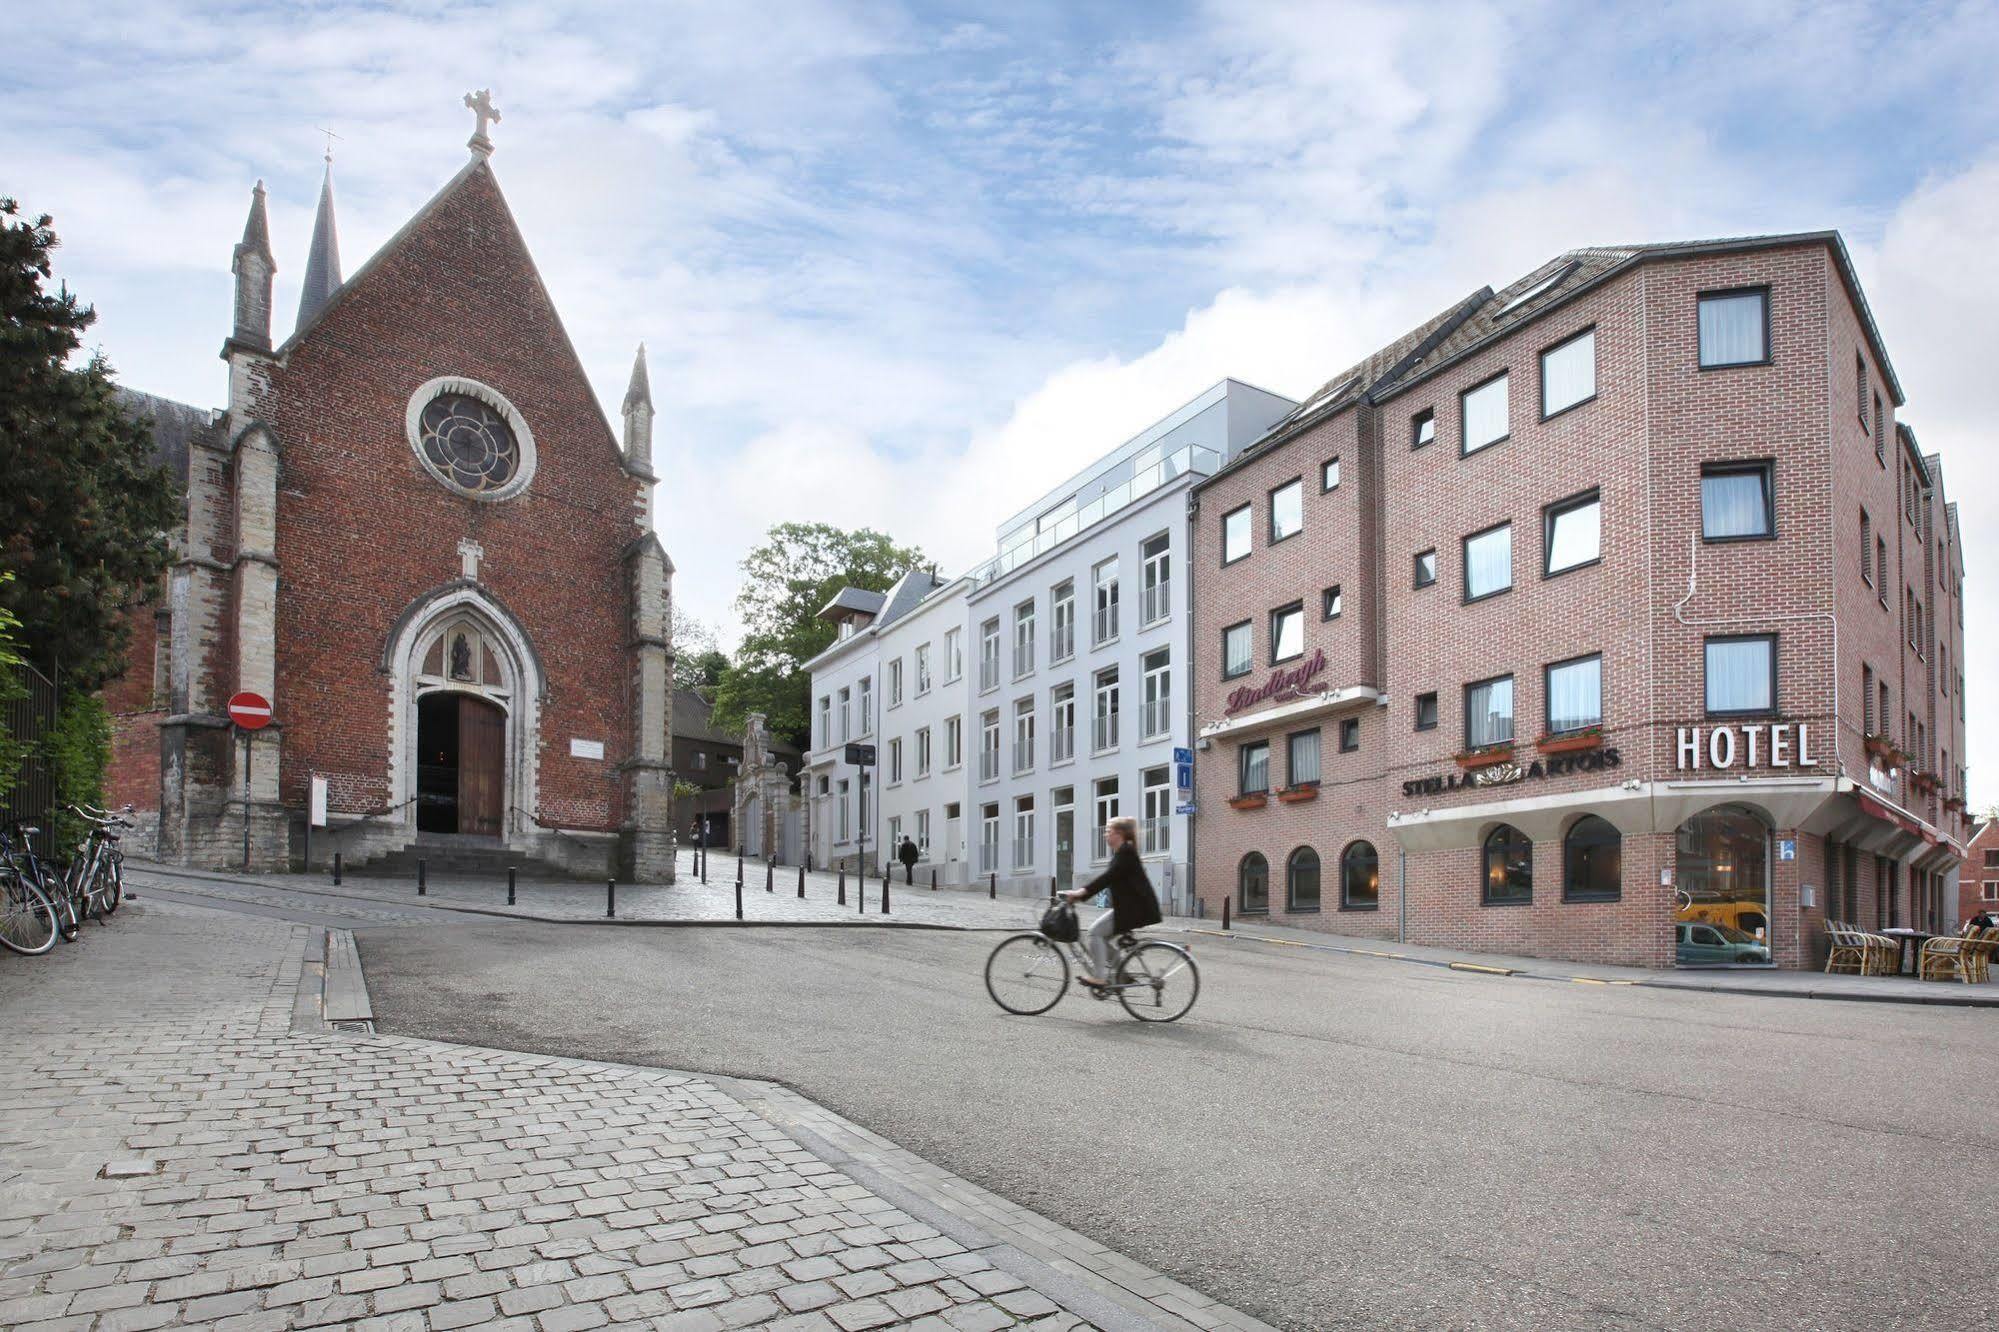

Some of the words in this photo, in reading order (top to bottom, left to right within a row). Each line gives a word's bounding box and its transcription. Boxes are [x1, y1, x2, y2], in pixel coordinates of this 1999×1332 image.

[1676, 723, 1818, 769] HOTEL
[1402, 771, 1477, 797] STELLA
[1527, 747, 1620, 778] ARTOIS
